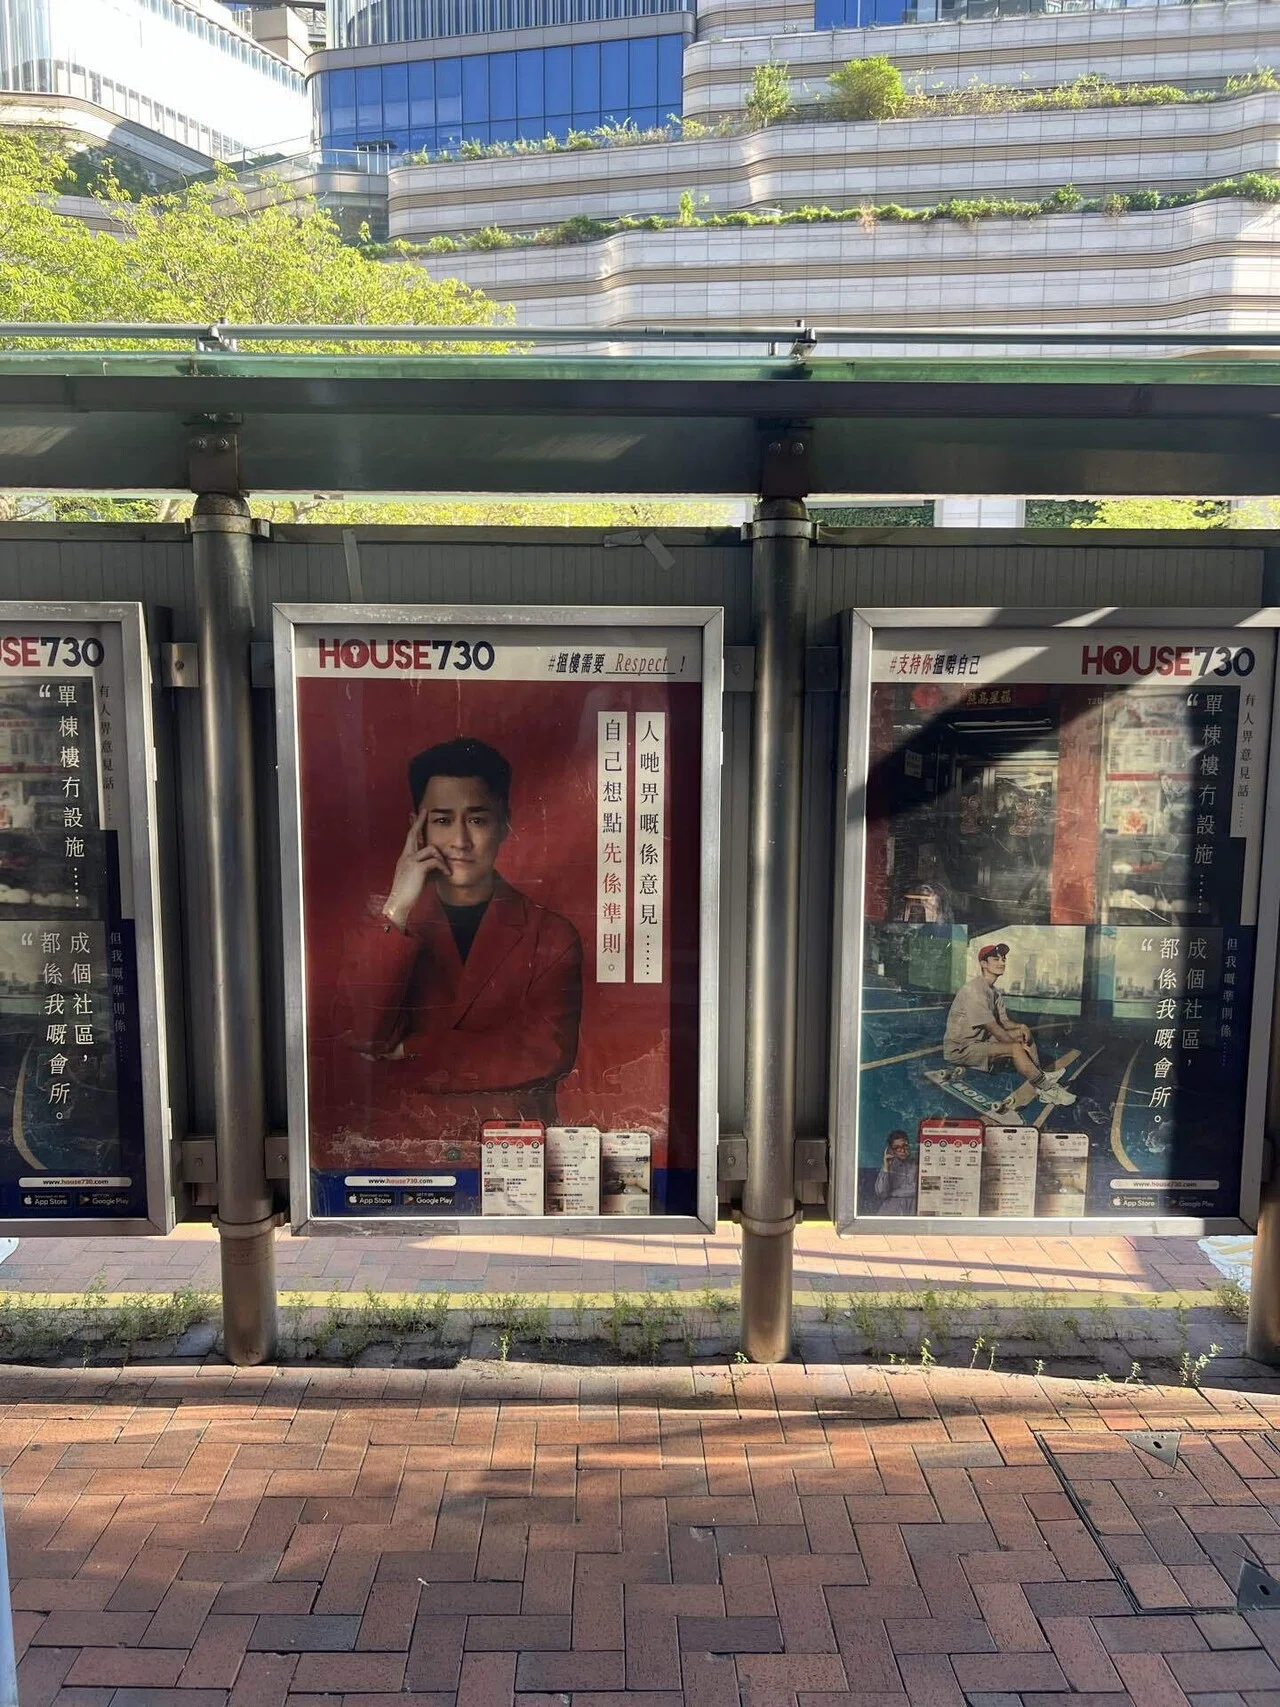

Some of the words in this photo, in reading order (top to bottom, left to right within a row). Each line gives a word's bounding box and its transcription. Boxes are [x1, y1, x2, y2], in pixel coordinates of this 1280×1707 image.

[0, 636, 105, 668] SE730
[318, 638, 495, 671] HOUSE730
[615, 653, 668, 676] Respect
[1081, 645, 1255, 676] HOUSE730
[34, 1198, 48, 1206] App
[92, 1198, 115, 1206] Google
[115, 1198, 129, 1206] Play
[360, 1197, 373, 1205] App
[416, 1196, 439, 1205] Google
[439, 1196, 453, 1206] Play
[1122, 1199, 1136, 1207] App
[1137, 1199, 1155, 1207] Store
